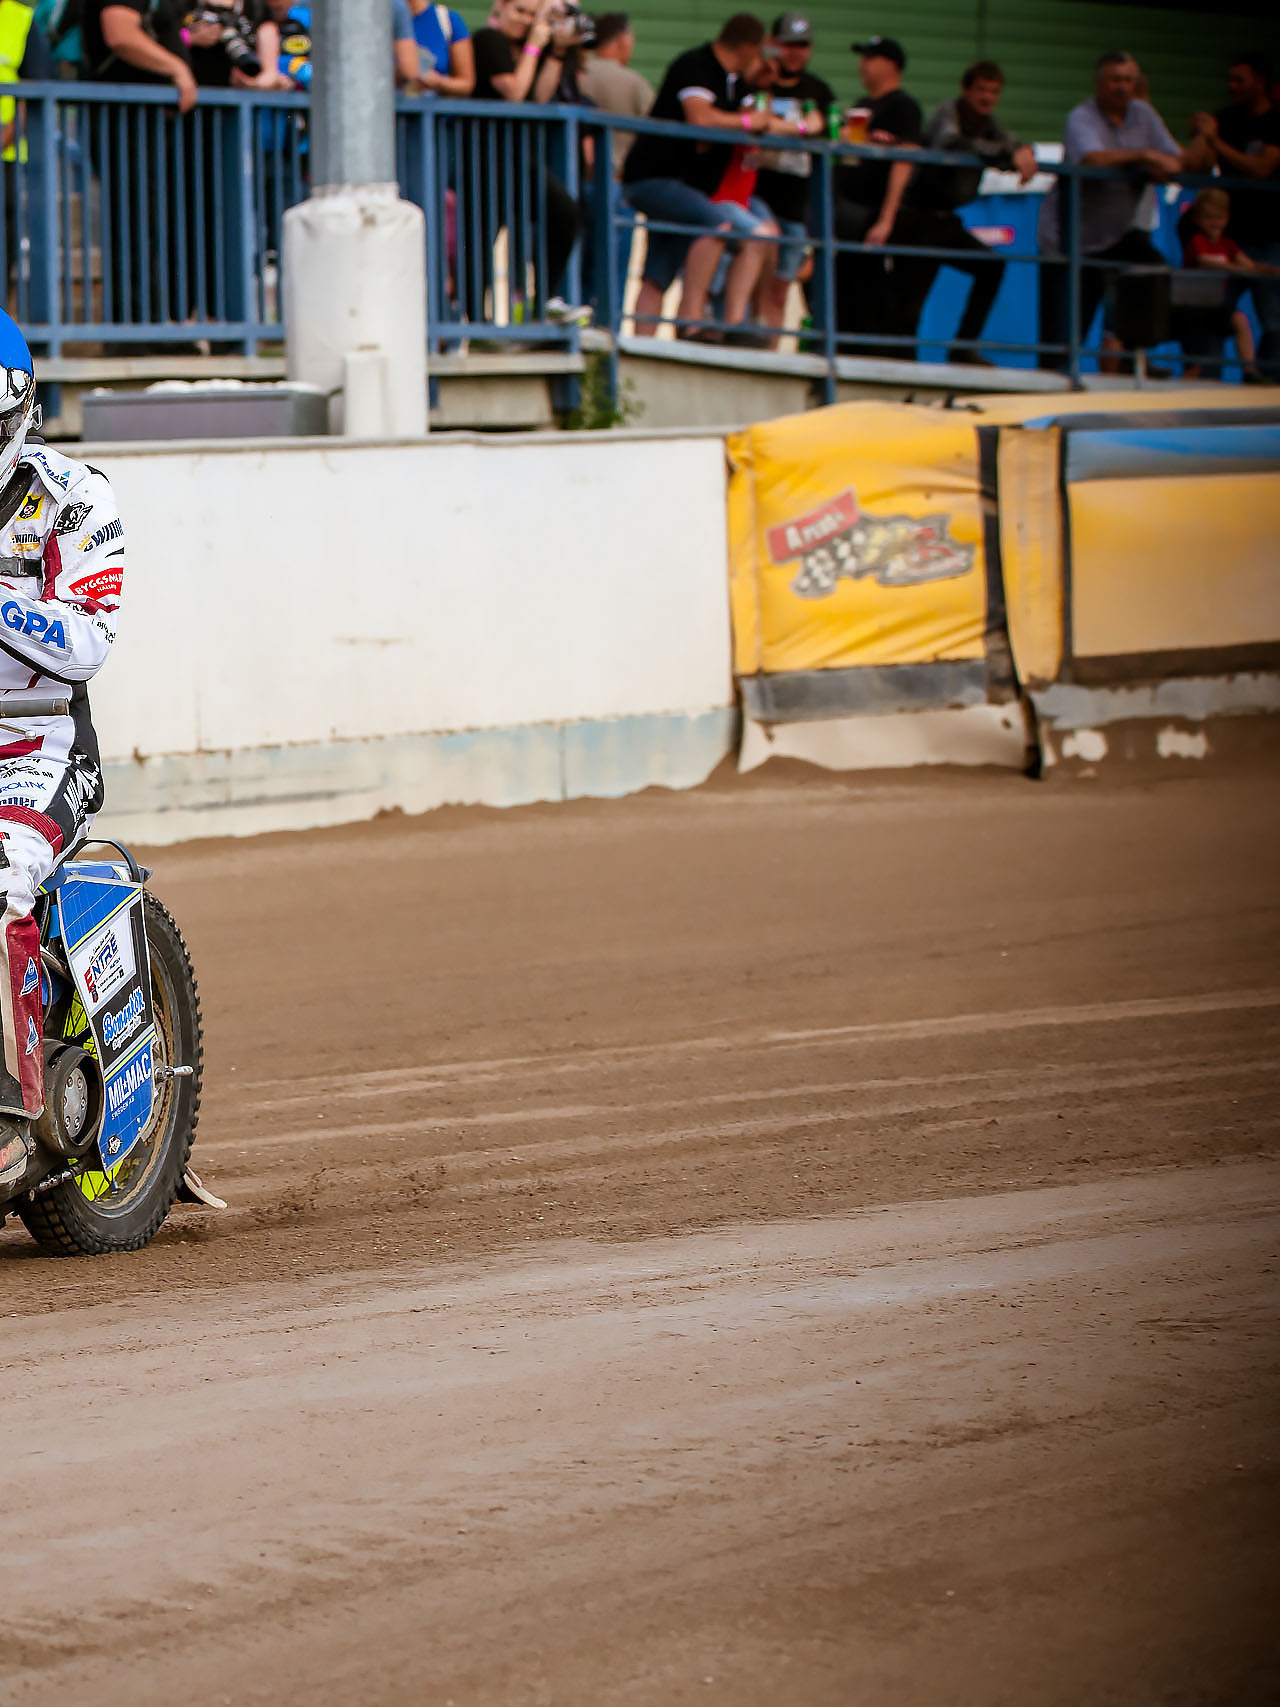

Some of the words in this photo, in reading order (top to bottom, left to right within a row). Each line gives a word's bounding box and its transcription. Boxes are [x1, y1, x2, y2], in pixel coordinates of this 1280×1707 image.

[1, 600, 66, 649] GPA
[83, 933, 118, 994] ENTRE
[111, 1102, 129, 1121] SWEDEN
